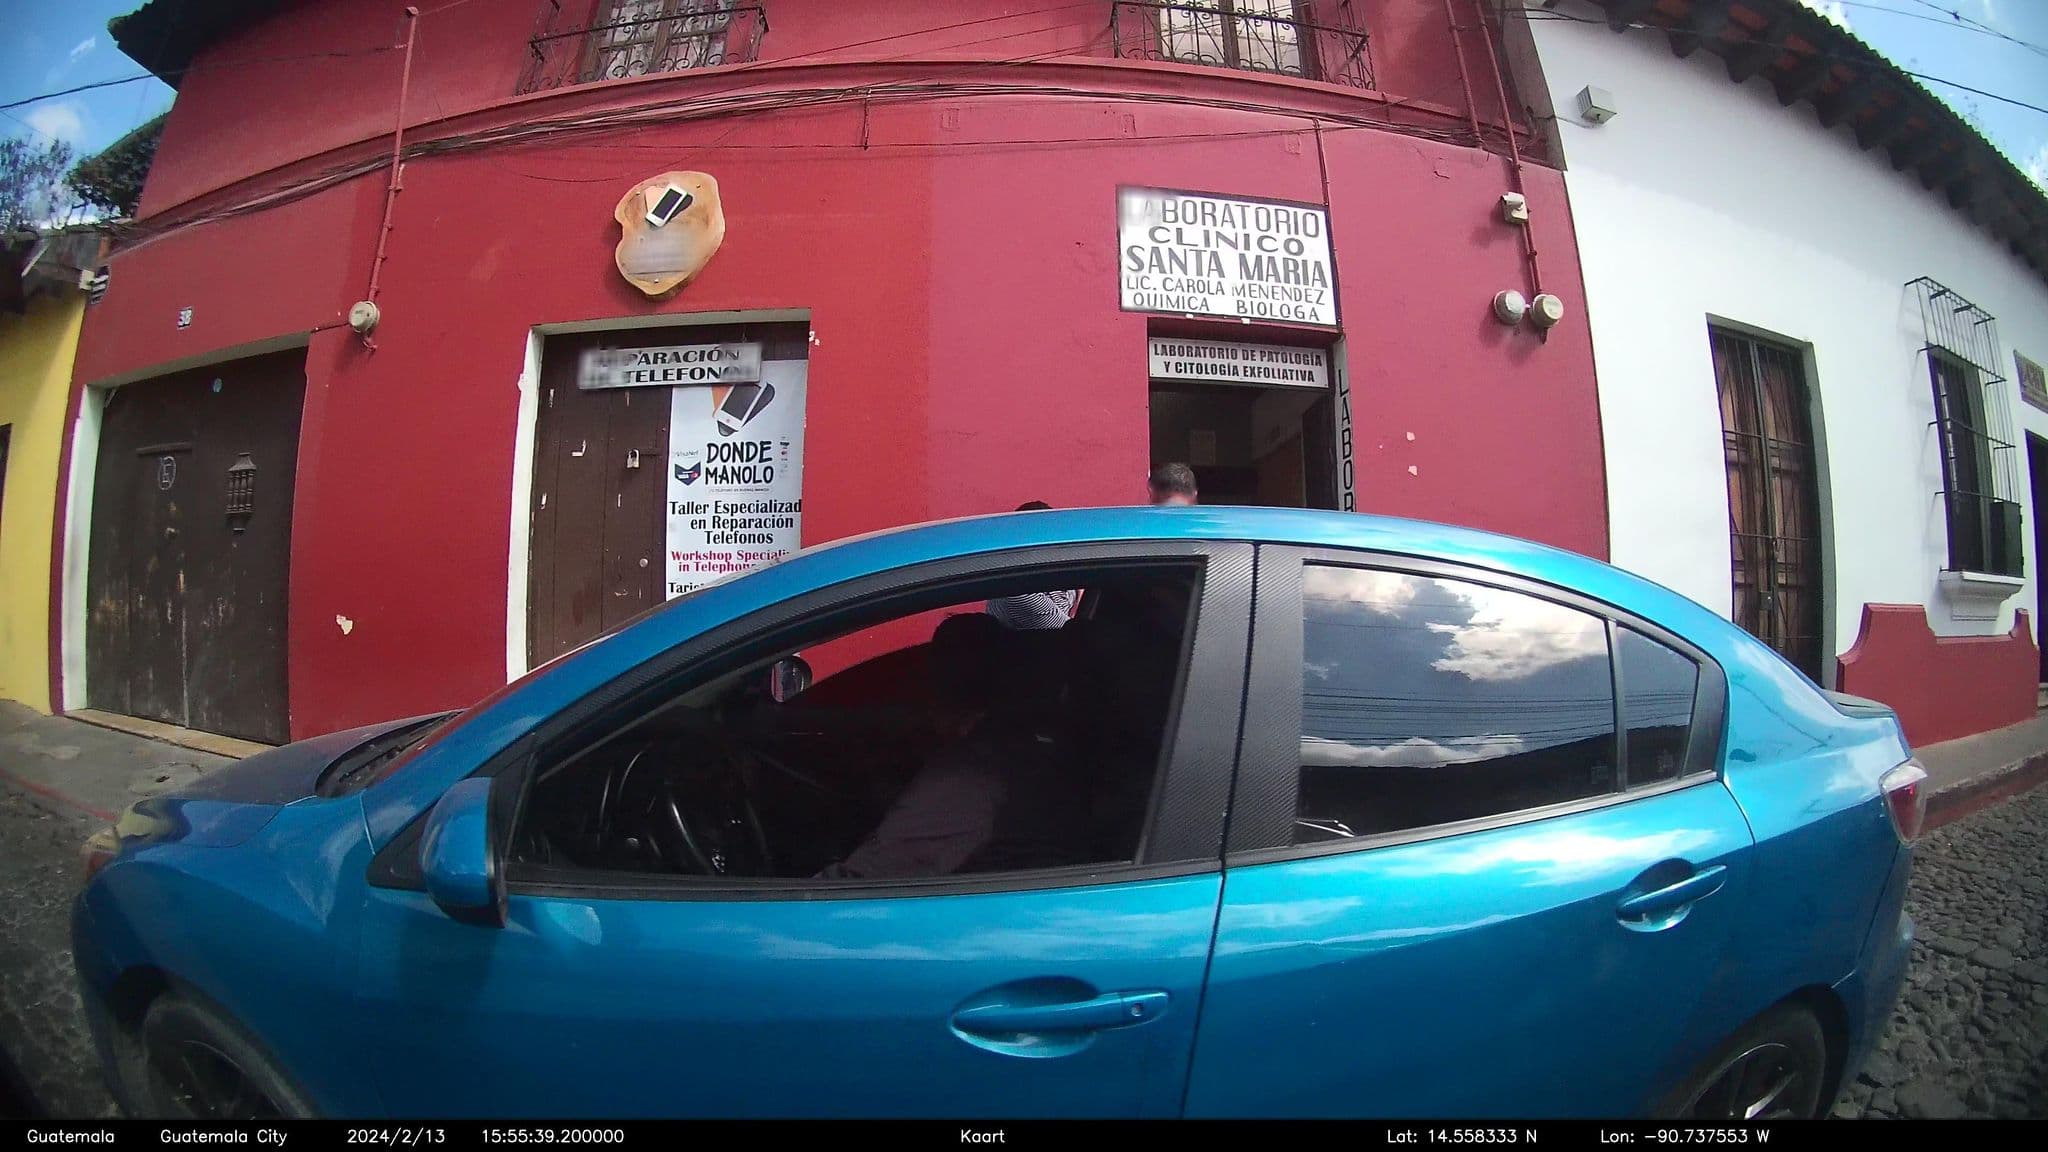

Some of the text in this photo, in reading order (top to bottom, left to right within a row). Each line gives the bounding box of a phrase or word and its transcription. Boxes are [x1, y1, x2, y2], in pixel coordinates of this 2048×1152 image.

[1149, 226, 1304, 257] CLINICO
[1126, 245, 1328, 288] SANTA MARIA
[1126, 276, 1326, 305] LIC. CAROLA MENENDEZ
[1236, 300, 1320, 322] BIOLOGA
[1154, 343, 1322, 367] LABORATORIO DE PATOLOGÍA
[1163, 361, 1315, 382] Y CITOLOGÍA EXFOLIATIVA
[706, 440, 773, 464] DONDE
[705, 465, 774, 485] MANOLO
[669, 499, 802, 517] Taller Especializad
[690, 514, 794, 532] en Reparación
[704, 530, 774, 545] Telefonos
[671, 550, 732, 563] Workshop
[678, 562, 757, 574] in Telephon
